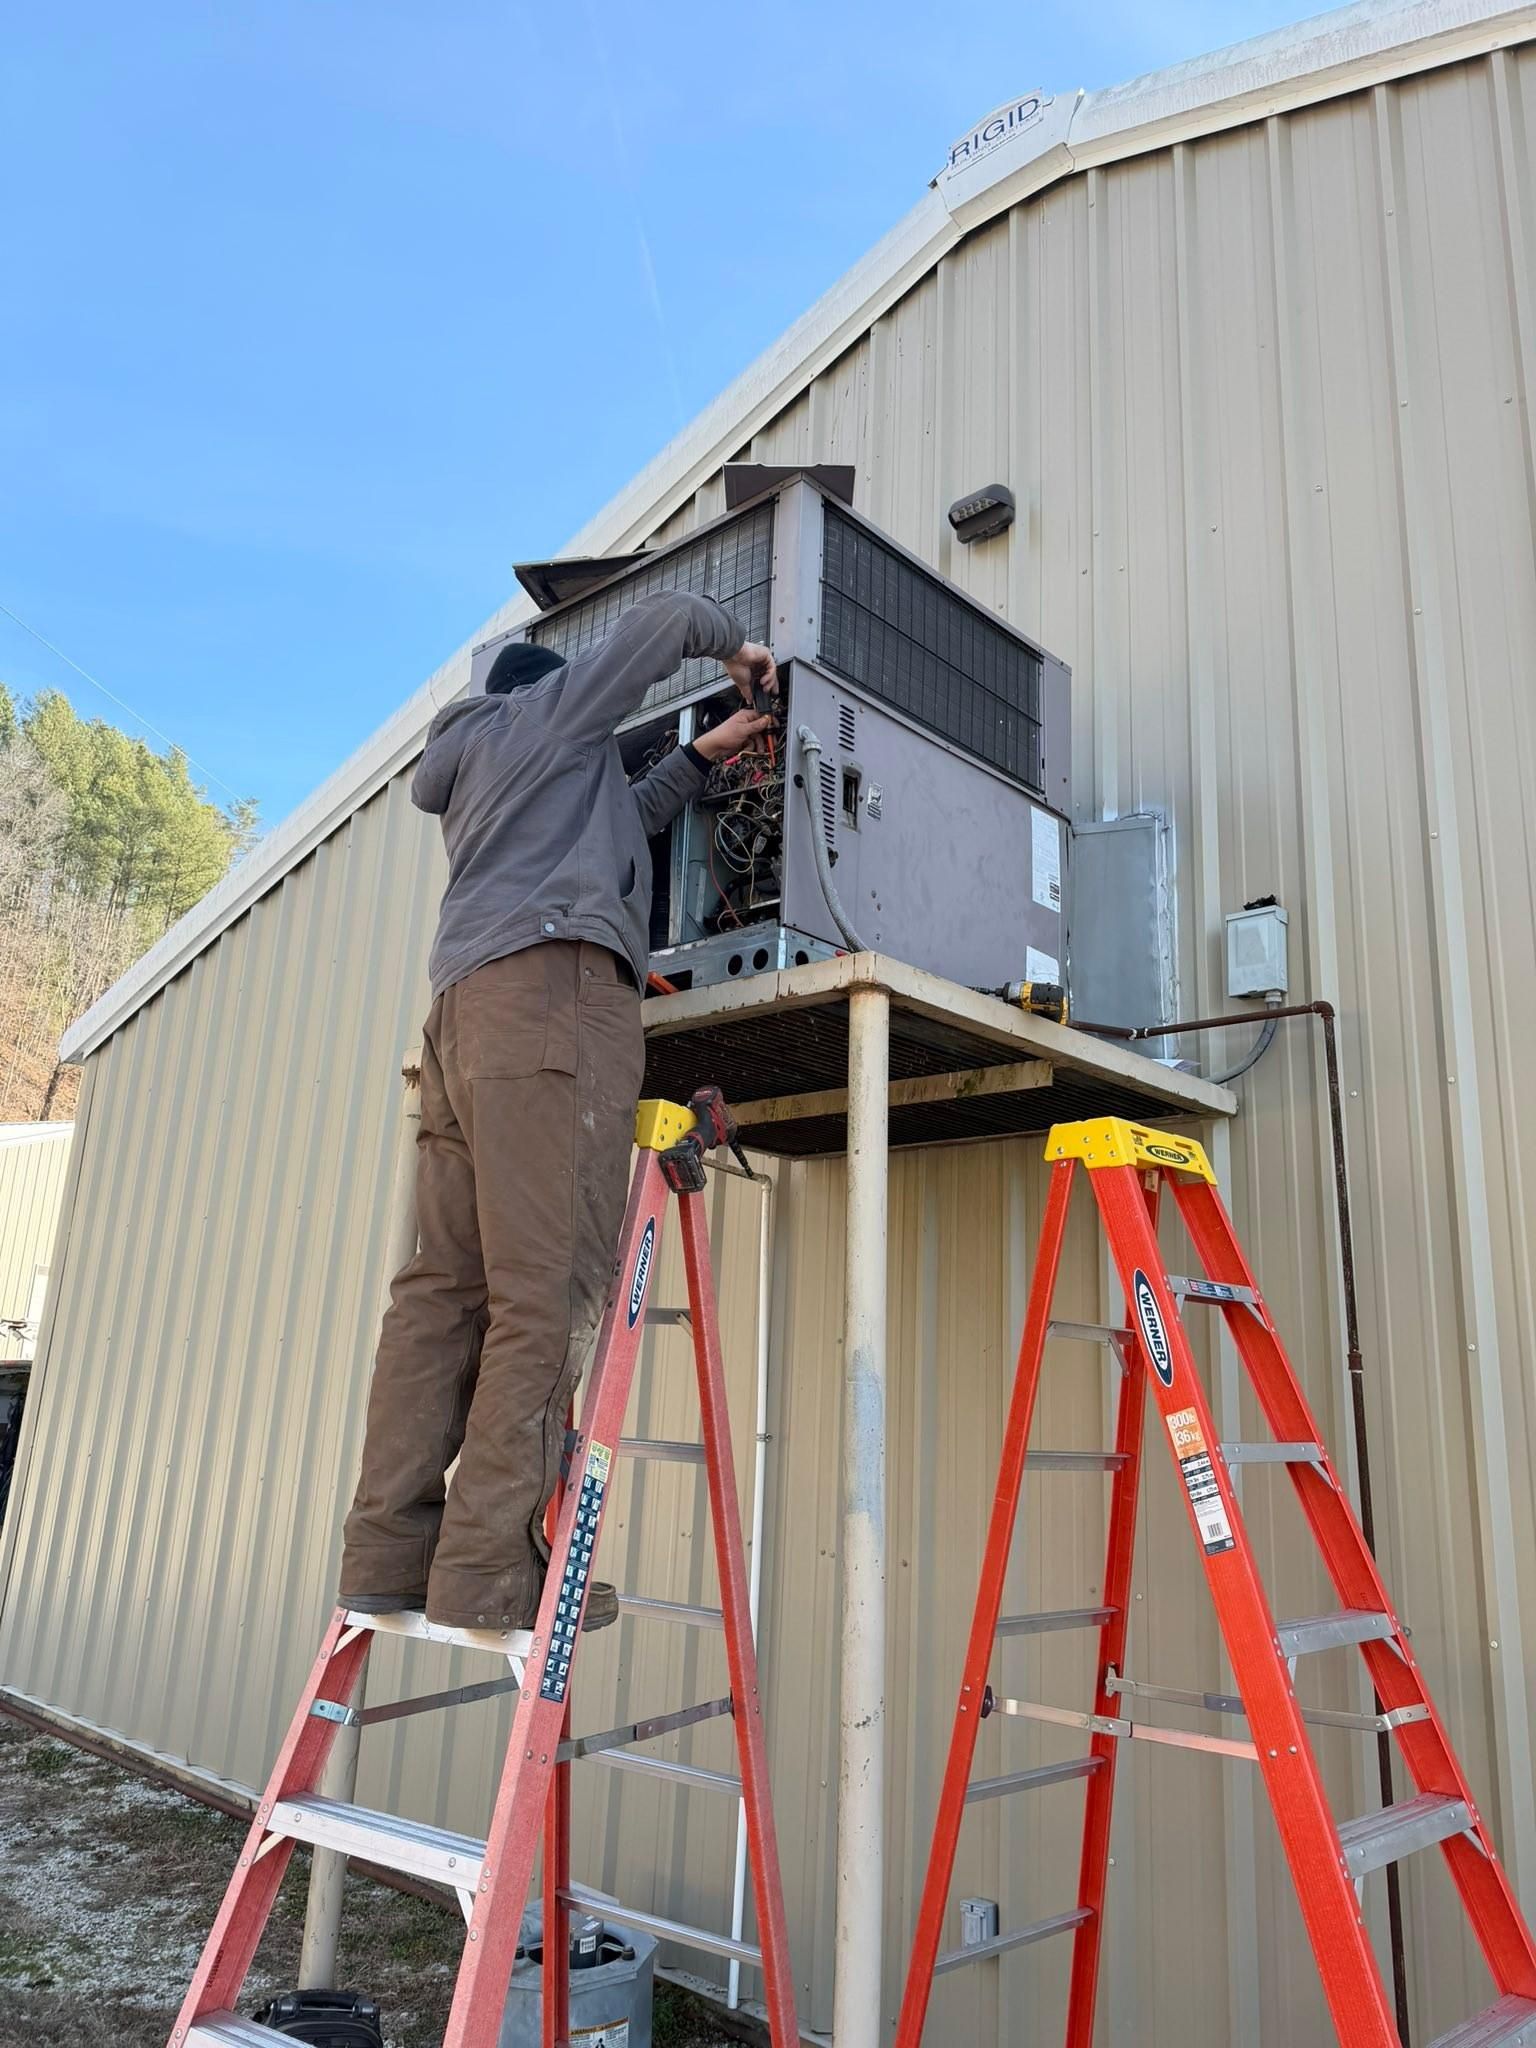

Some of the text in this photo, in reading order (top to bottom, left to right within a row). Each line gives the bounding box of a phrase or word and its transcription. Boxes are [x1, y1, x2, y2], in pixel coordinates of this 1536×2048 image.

[951, 98, 1039, 165] RIGID
[1153, 1147, 1183, 1161] WERNER
[632, 1236, 652, 1305] WERNER
[1140, 1291, 1167, 1363] WERNER
